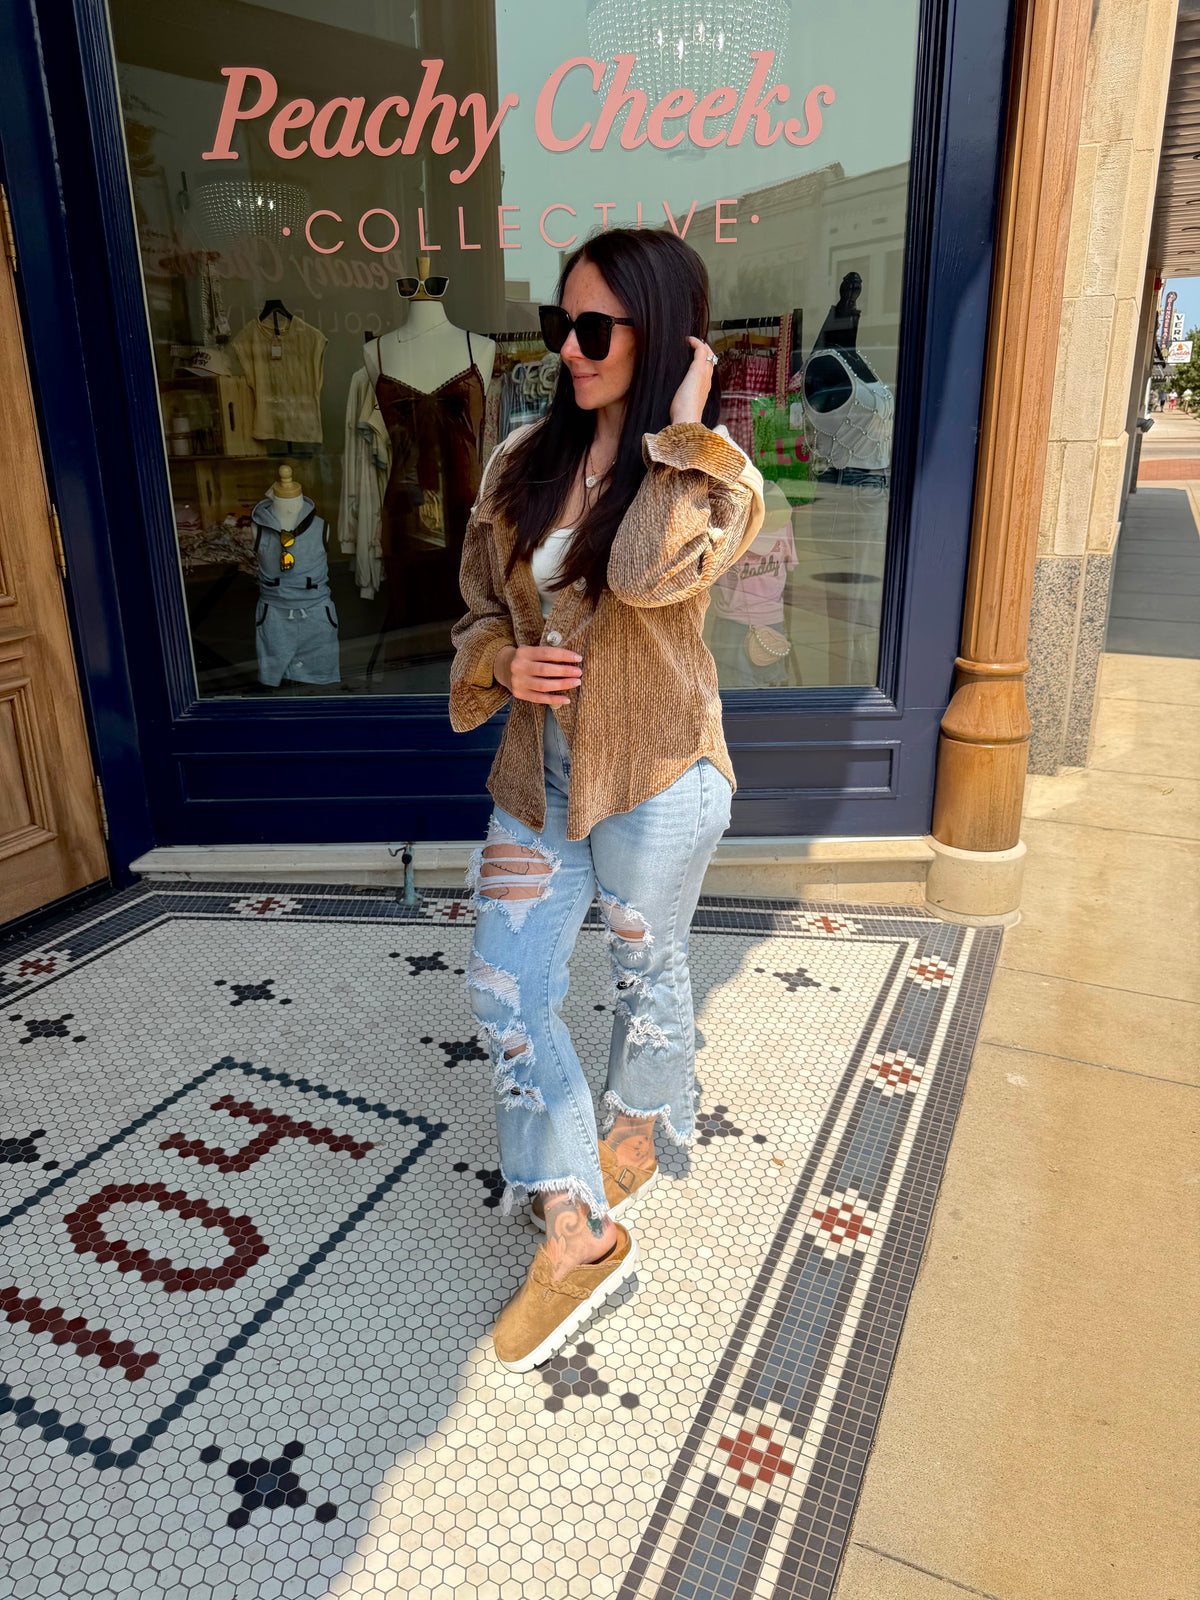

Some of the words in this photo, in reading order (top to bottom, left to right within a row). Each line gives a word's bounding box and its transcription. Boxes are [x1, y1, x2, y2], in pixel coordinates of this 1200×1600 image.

[202, 59, 520, 185] Peachy
[534, 50, 836, 153] Cheeks
[0, 1095, 376, 1381] 104
